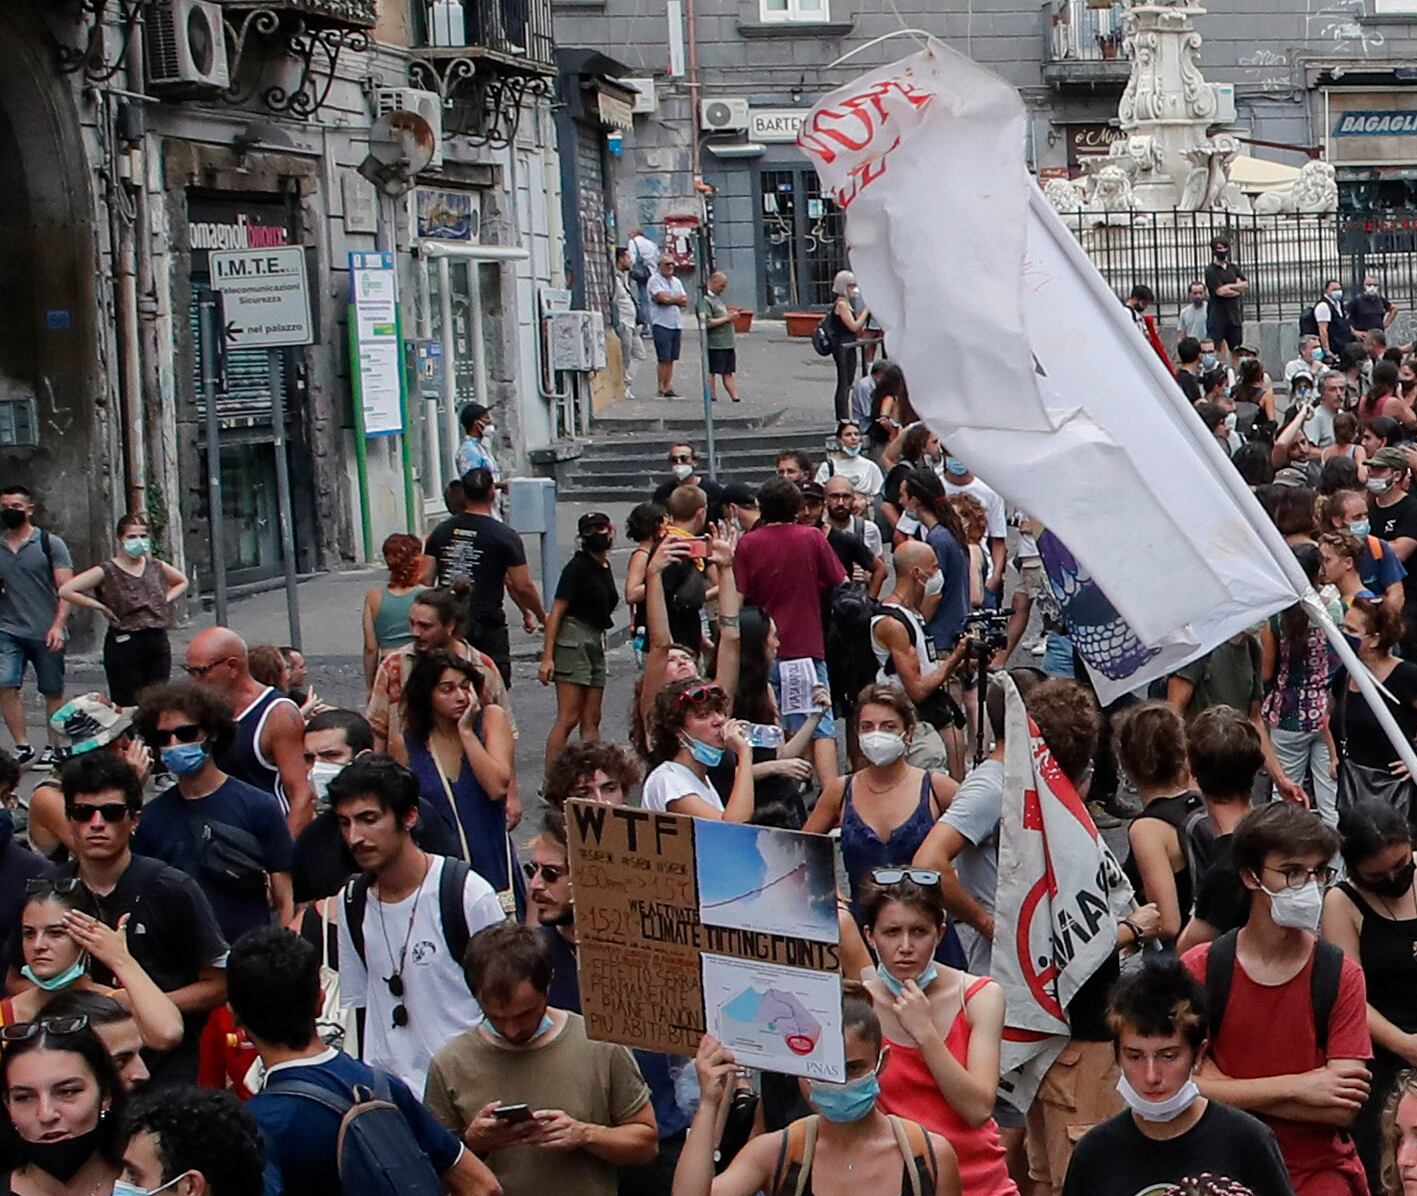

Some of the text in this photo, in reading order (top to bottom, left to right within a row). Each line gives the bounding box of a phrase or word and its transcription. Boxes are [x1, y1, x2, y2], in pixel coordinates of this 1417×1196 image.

[189, 213, 247, 249] omagnoli
[239, 294, 282, 305] Sicurezza
[247, 321, 303, 335] nel palazzo
[571, 803, 679, 855] WTF
[629, 899, 700, 922] WE ACTIVATE
[641, 914, 701, 948] CLIMATE
[703, 926, 769, 961] TIPPING
[771, 935, 841, 971] POINTS
[805, 1059, 839, 1077] PNAS
